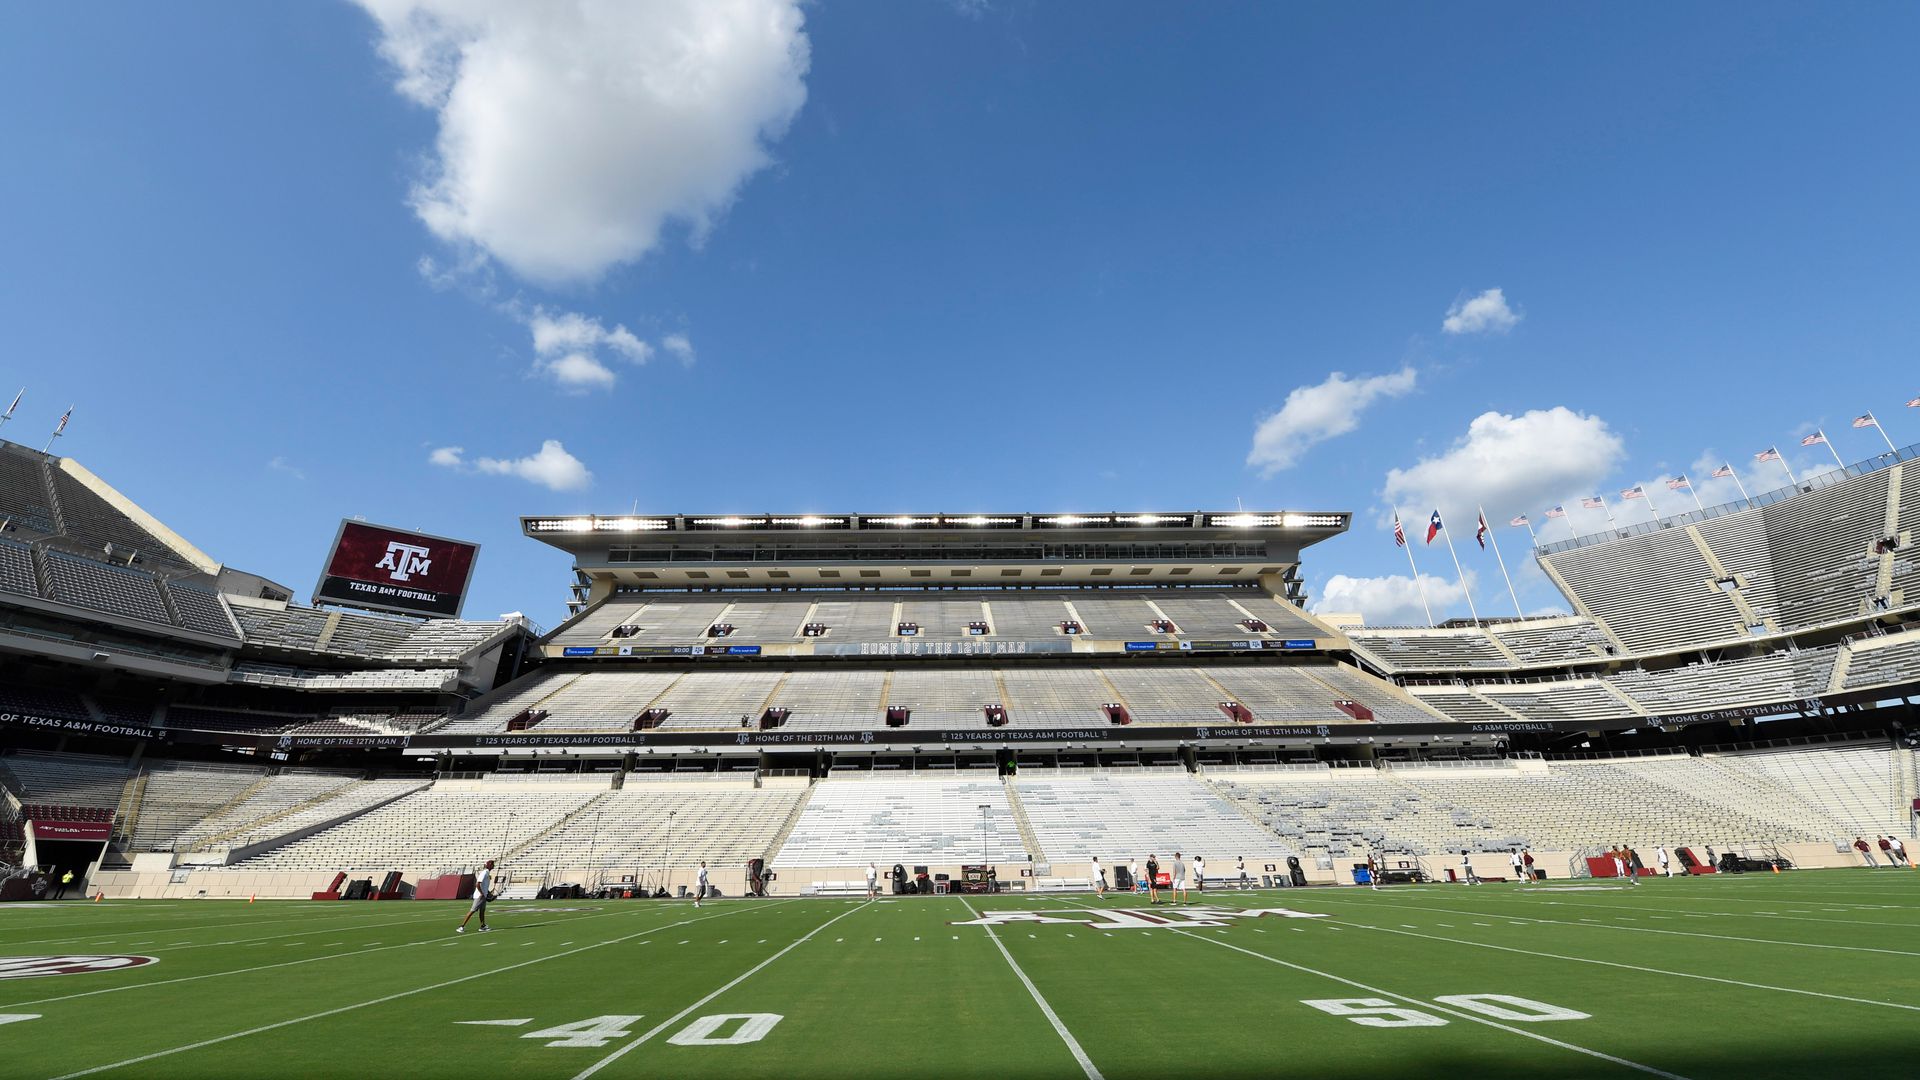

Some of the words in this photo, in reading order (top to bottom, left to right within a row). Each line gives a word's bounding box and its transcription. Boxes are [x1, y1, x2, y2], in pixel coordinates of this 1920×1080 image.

[350, 582, 377, 593] TEXAS
[378, 587, 396, 596] A&M
[397, 589, 437, 602] FOOTBALL
[861, 643, 898, 654] HOME
[903, 643, 919, 654] OF
[926, 642, 952, 654] THE
[958, 642, 991, 653] 12TH
[996, 642, 1026, 653] MAN
[1668, 715, 1699, 724] HOME
[1701, 712, 1716, 721] OF
[1719, 710, 1740, 719] THE
[1742, 707, 1769, 716] 12TH
[1771, 703, 1799, 713] MAN
[1, 713, 19, 722] OF
[22, 715, 61, 727] TEXAS
[64, 721, 91, 732] A&M
[94, 724, 153, 738] FOOTBALL
[485, 737, 498, 745] 125
[593, 736, 636, 744] FOOTBALL
[1299, 994, 1592, 1027] 50
[520, 1013, 784, 1047] 40
